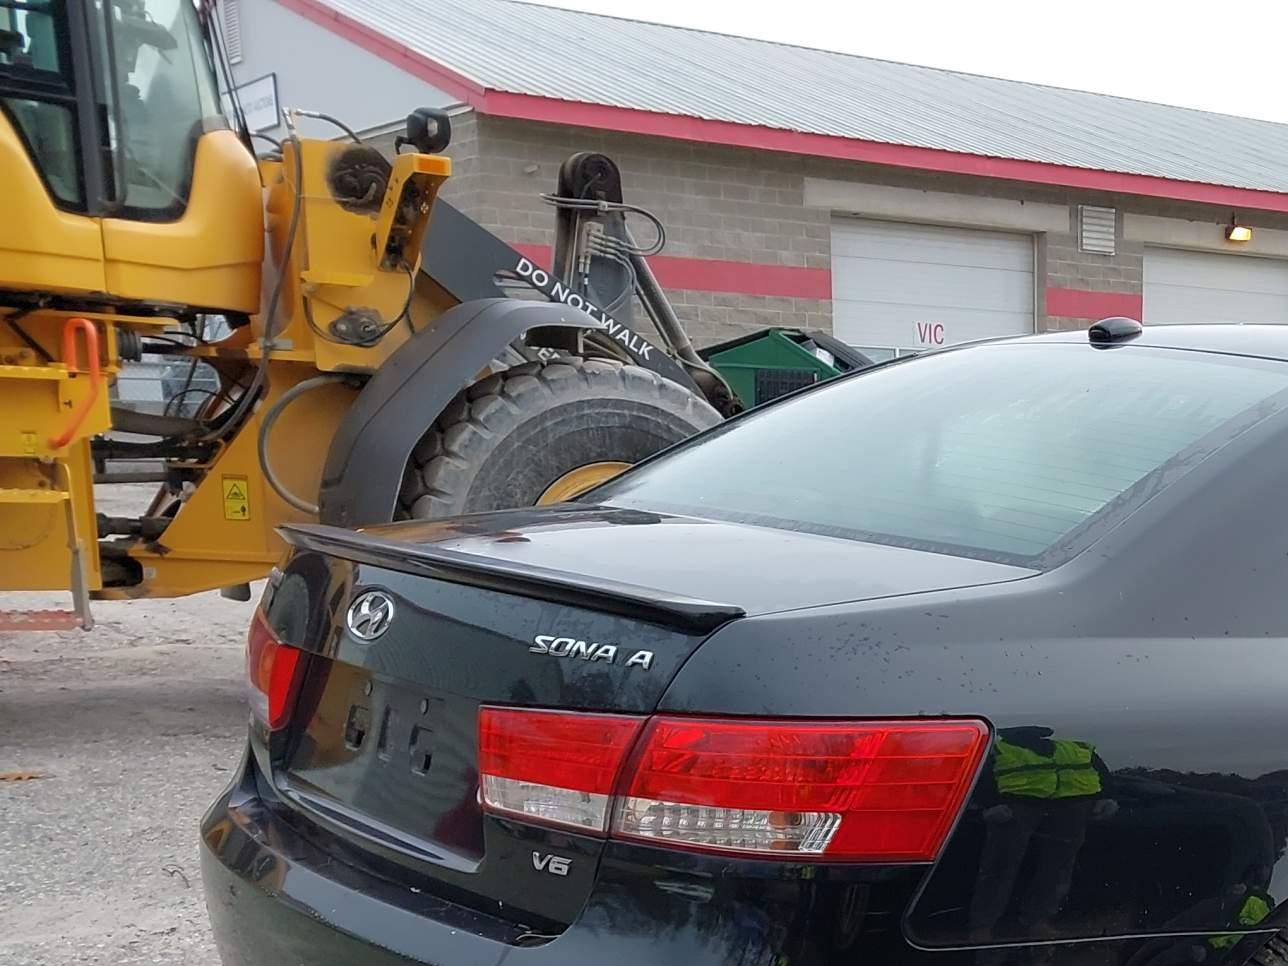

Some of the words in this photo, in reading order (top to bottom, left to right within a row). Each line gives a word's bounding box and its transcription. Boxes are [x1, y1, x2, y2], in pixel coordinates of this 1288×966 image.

[516, 257, 549, 287] DO
[551, 282, 598, 315] NOT
[600, 312, 654, 361] WALK
[917, 322, 944, 345] VIC
[532, 851, 573, 876] V6
